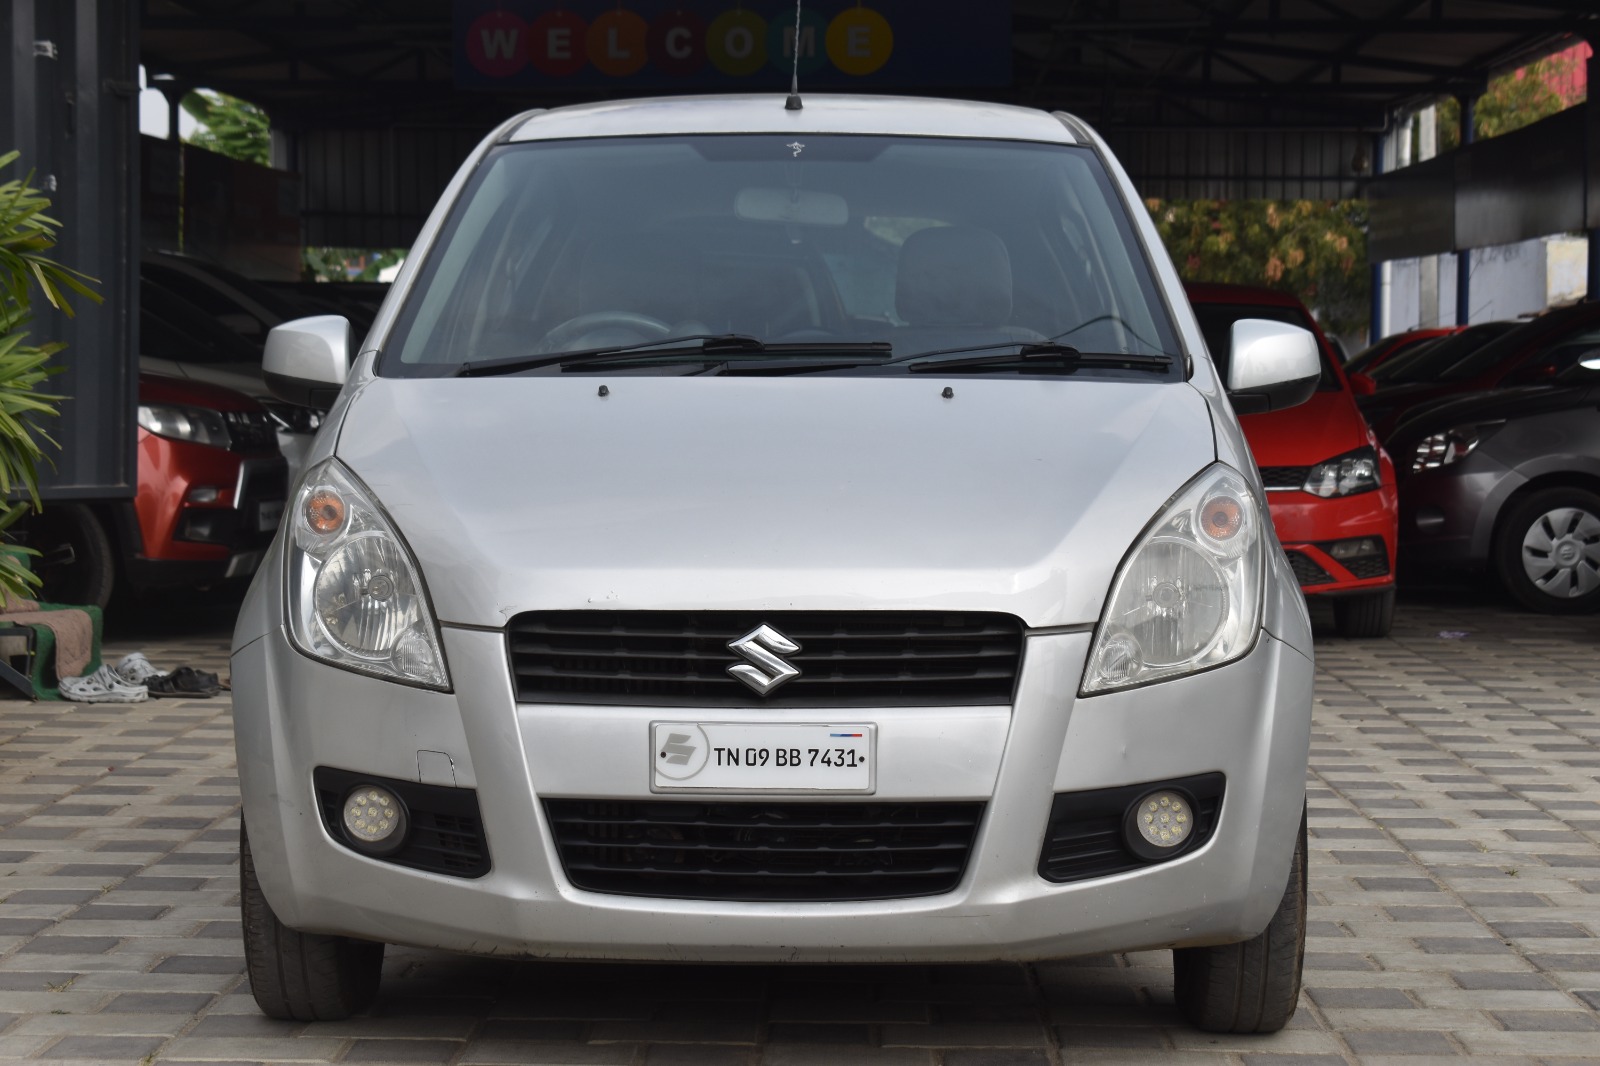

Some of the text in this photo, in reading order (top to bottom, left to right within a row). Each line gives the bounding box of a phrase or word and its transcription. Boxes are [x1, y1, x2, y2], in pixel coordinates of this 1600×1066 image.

[480, 27, 872, 60] WELCOME
[714, 747, 858, 768] TN 09 BB 7431
